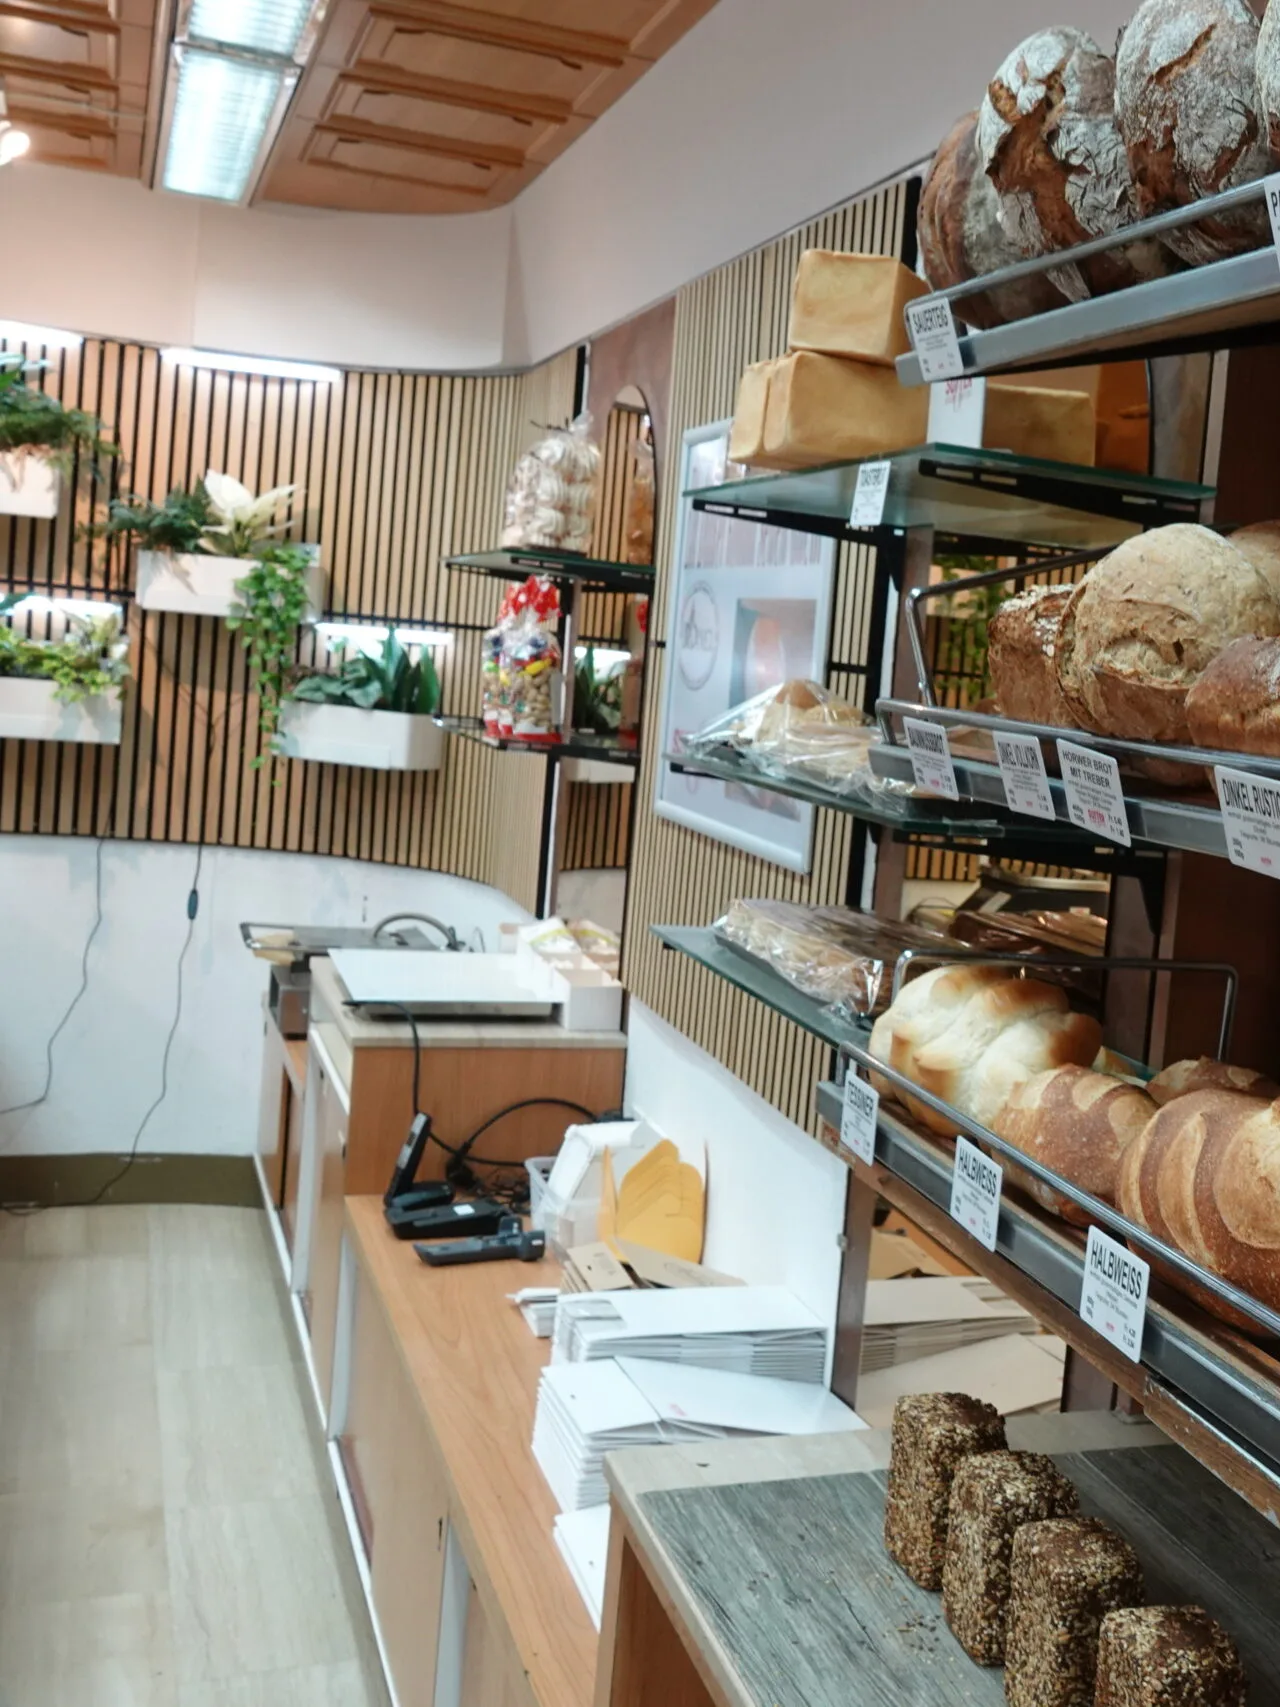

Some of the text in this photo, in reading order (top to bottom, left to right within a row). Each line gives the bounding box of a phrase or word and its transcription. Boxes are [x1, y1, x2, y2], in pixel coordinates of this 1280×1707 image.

[1070, 767, 1110, 788] MIT TREBER
[1093, 760, 1112, 775] BROT
[1222, 778, 1254, 812] DINKEL
[959, 1154, 997, 1197] HALBWEISS
[1091, 1243, 1142, 1299] HALBWEISS
